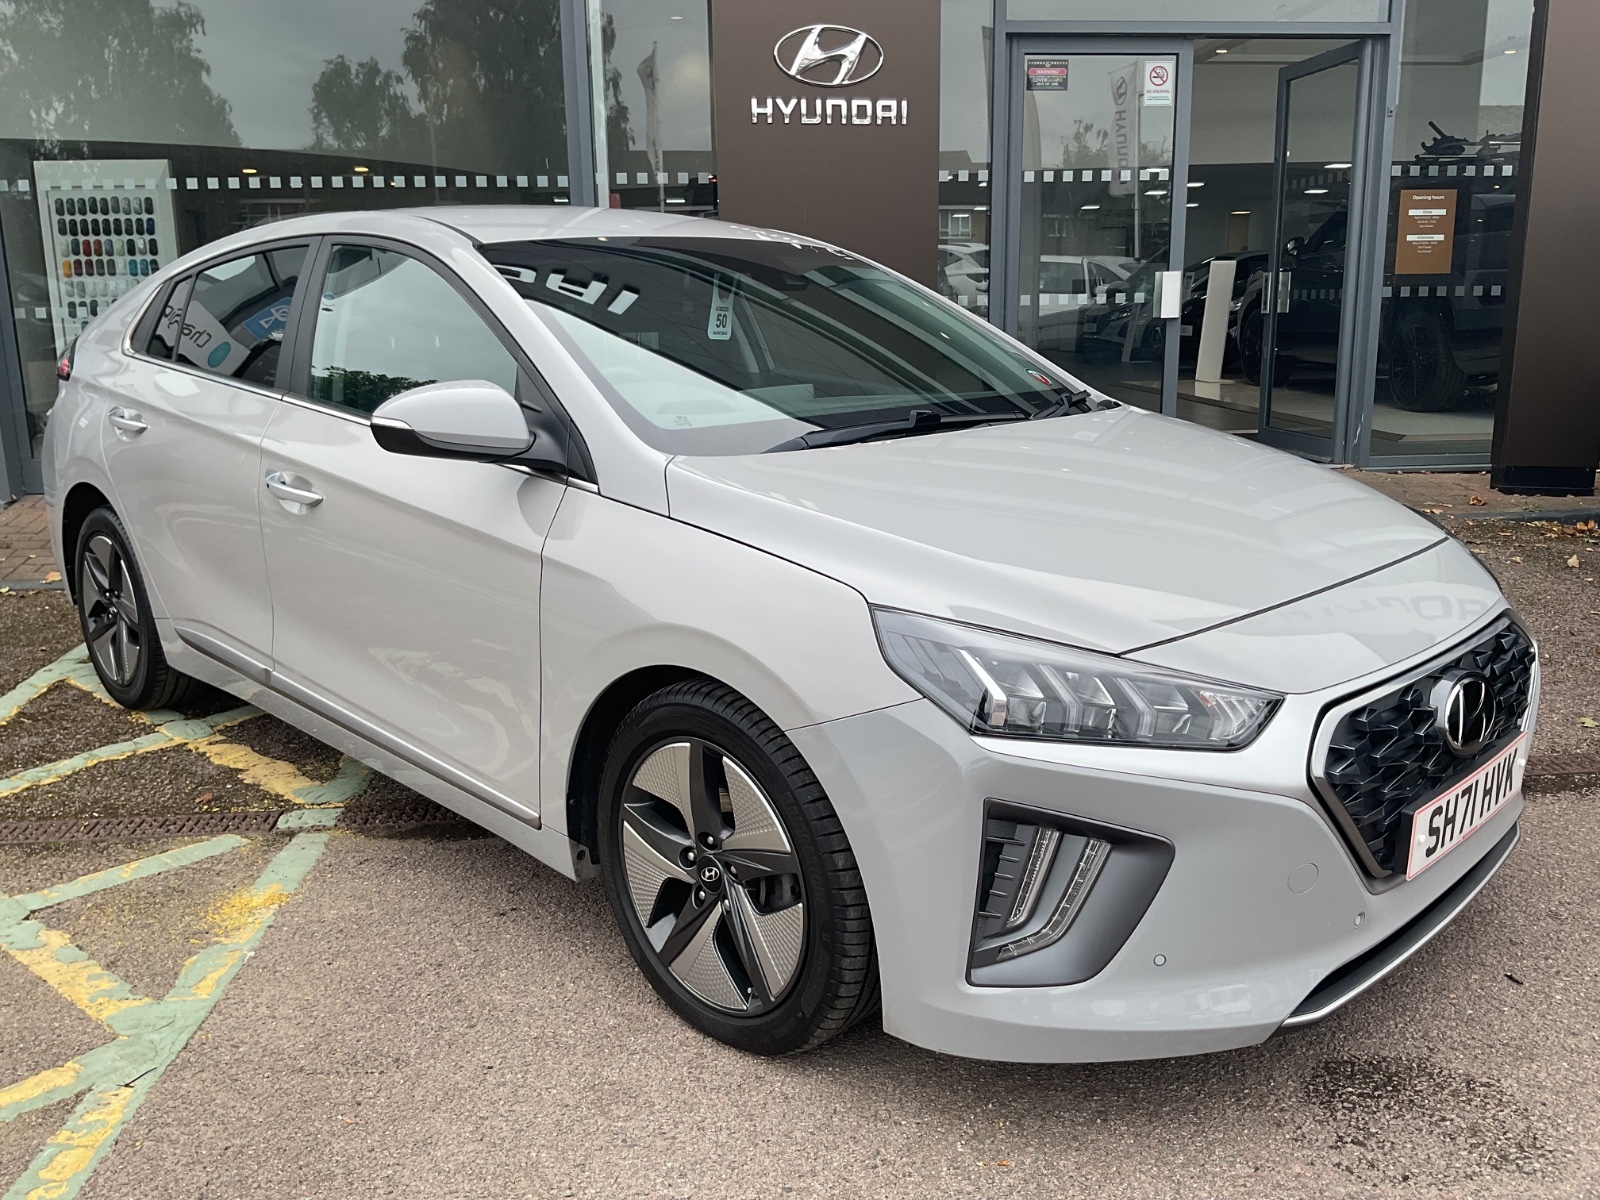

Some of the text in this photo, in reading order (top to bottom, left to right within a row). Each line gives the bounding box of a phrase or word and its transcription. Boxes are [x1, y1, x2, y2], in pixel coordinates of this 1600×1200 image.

[750, 98, 908, 125] HYUNDAI
[715, 313, 728, 329] 50
[1425, 747, 1518, 858] SH71 HVK
